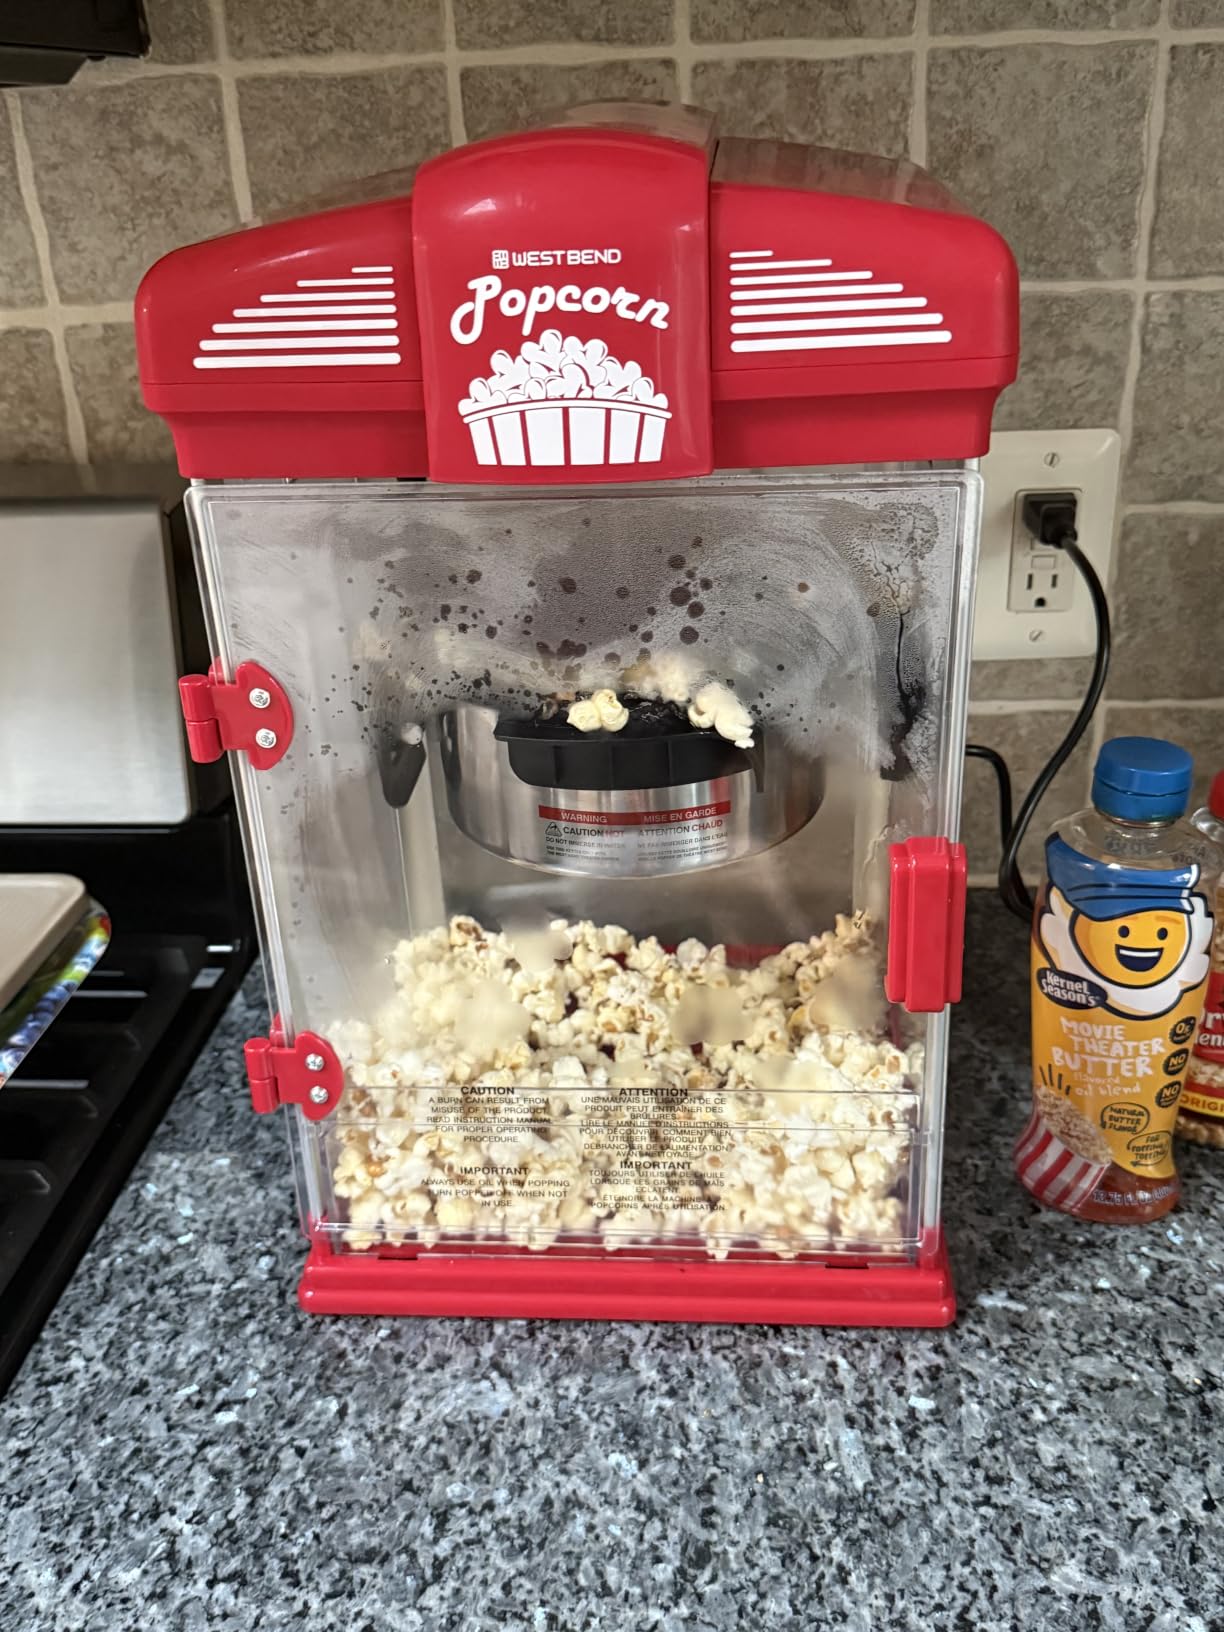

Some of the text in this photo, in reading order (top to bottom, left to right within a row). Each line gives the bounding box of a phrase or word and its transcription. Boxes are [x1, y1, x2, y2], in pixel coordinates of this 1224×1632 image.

[450, 275, 670, 345] Popcorn
[561, 812, 608, 823] WARNING
[643, 807, 717, 823] MISE EN GARDE
[563, 827, 603, 837] CAUTION
[639, 820, 723, 837] ATTENTION CHAUD
[1046, 970, 1090, 996] Kernel
[1041, 979, 1097, 1007] Season's
[1060, 1016, 1125, 1041] MOVIE
[1068, 1036, 1166, 1057] THEATER
[1051, 1046, 1153, 1078] BUTTER
[1169, 1053, 1187, 1067] NO
[460, 1086, 515, 1096] CAUTION
[619, 1087, 688, 1097] ATTENTION
[1162, 1084, 1180, 1098] NO
[437, 1097, 463, 1105] BURN
[465, 1097, 485, 1105] CAN
[487, 1097, 521, 1105] RESULT
[523, 1097, 550, 1105] FROM
[581, 1096, 601, 1104] UNE
[602, 1096, 641, 1104] MAUVAIS
[642, 1096, 697, 1105] UTILISATION
[713, 1097, 727, 1105] CE
[431, 1106, 547, 1115] MISUSE OF THE PRODUCT
[705, 1106, 724, 1114] DES
[453, 1116, 513, 1124] INSTRUCTION
[581, 1120, 600, 1128] LIRE
[435, 1125, 454, 1133] FOR
[496, 1126, 548, 1134] OPERATING
[579, 1127, 604, 1135] POUR
[662, 1128, 708, 1136] COMMENT
[710, 1129, 731, 1137] BIEN
[608, 1135, 647, 1143] UTILISER
[663, 1135, 702, 1143] PRODUIT
[645, 1143, 658, 1151] DE
[620, 1160, 692, 1170] IMPORTANT
[460, 1166, 529, 1175] IMPORTANT
[589, 1169, 635, 1177] TOUJOURS
[638, 1170, 677, 1178] UTILISER
[680, 1170, 692, 1178] DE
[421, 1178, 455, 1186] ALWAYS
[456, 1178, 476, 1186] USE
[527, 1179, 570, 1187] POPPING
[634, 1178, 650, 1186] LES
[653, 1179, 686, 1187] GRAINS
[689, 1179, 702, 1187] DE
[548, 1190, 568, 1198] NOT
[661, 1195, 702, 1203] MACHINE
[481, 1200, 491, 1208] IN
[592, 1201, 639, 1209] POPCORNS
